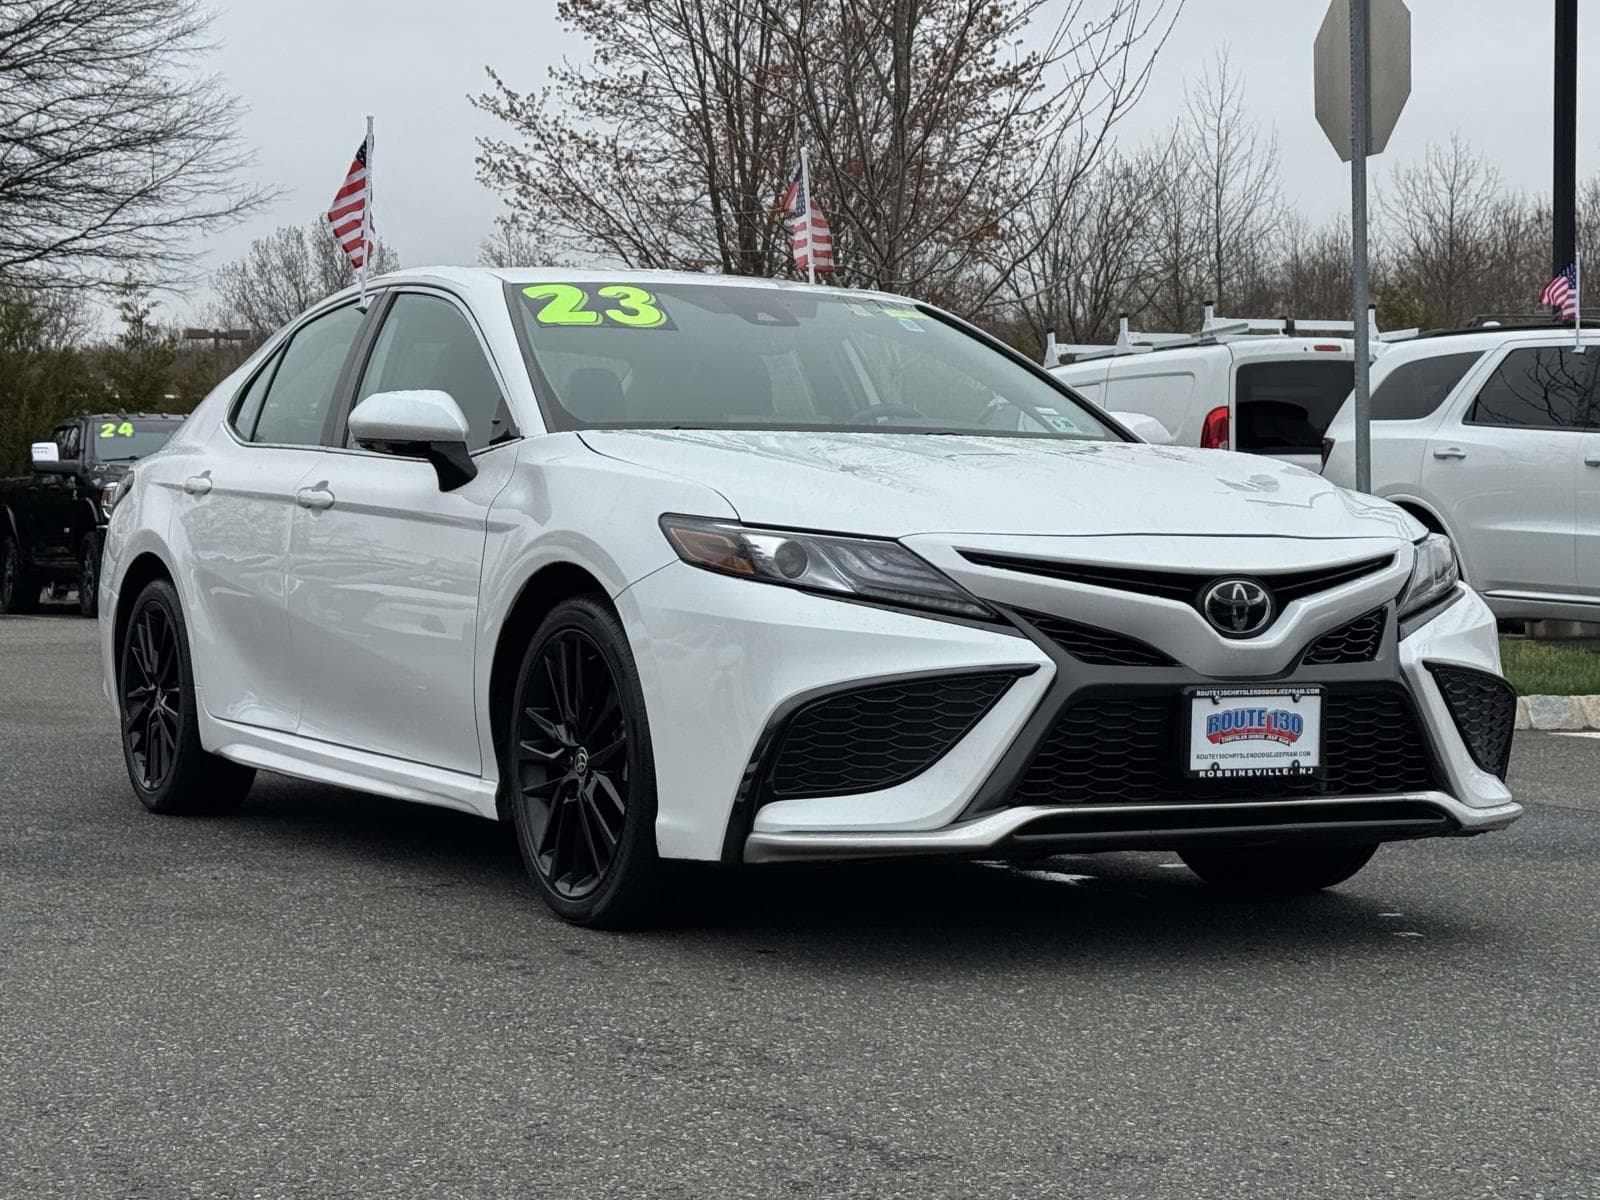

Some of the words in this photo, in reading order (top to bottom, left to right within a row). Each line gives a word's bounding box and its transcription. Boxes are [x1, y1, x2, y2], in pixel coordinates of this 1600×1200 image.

[521, 284, 667, 328] 23
[100, 422, 134, 438] 24
[1208, 708, 1267, 735] ROUTE
[1270, 709, 1302, 735] 130
[1299, 767, 1314, 775] NJ
